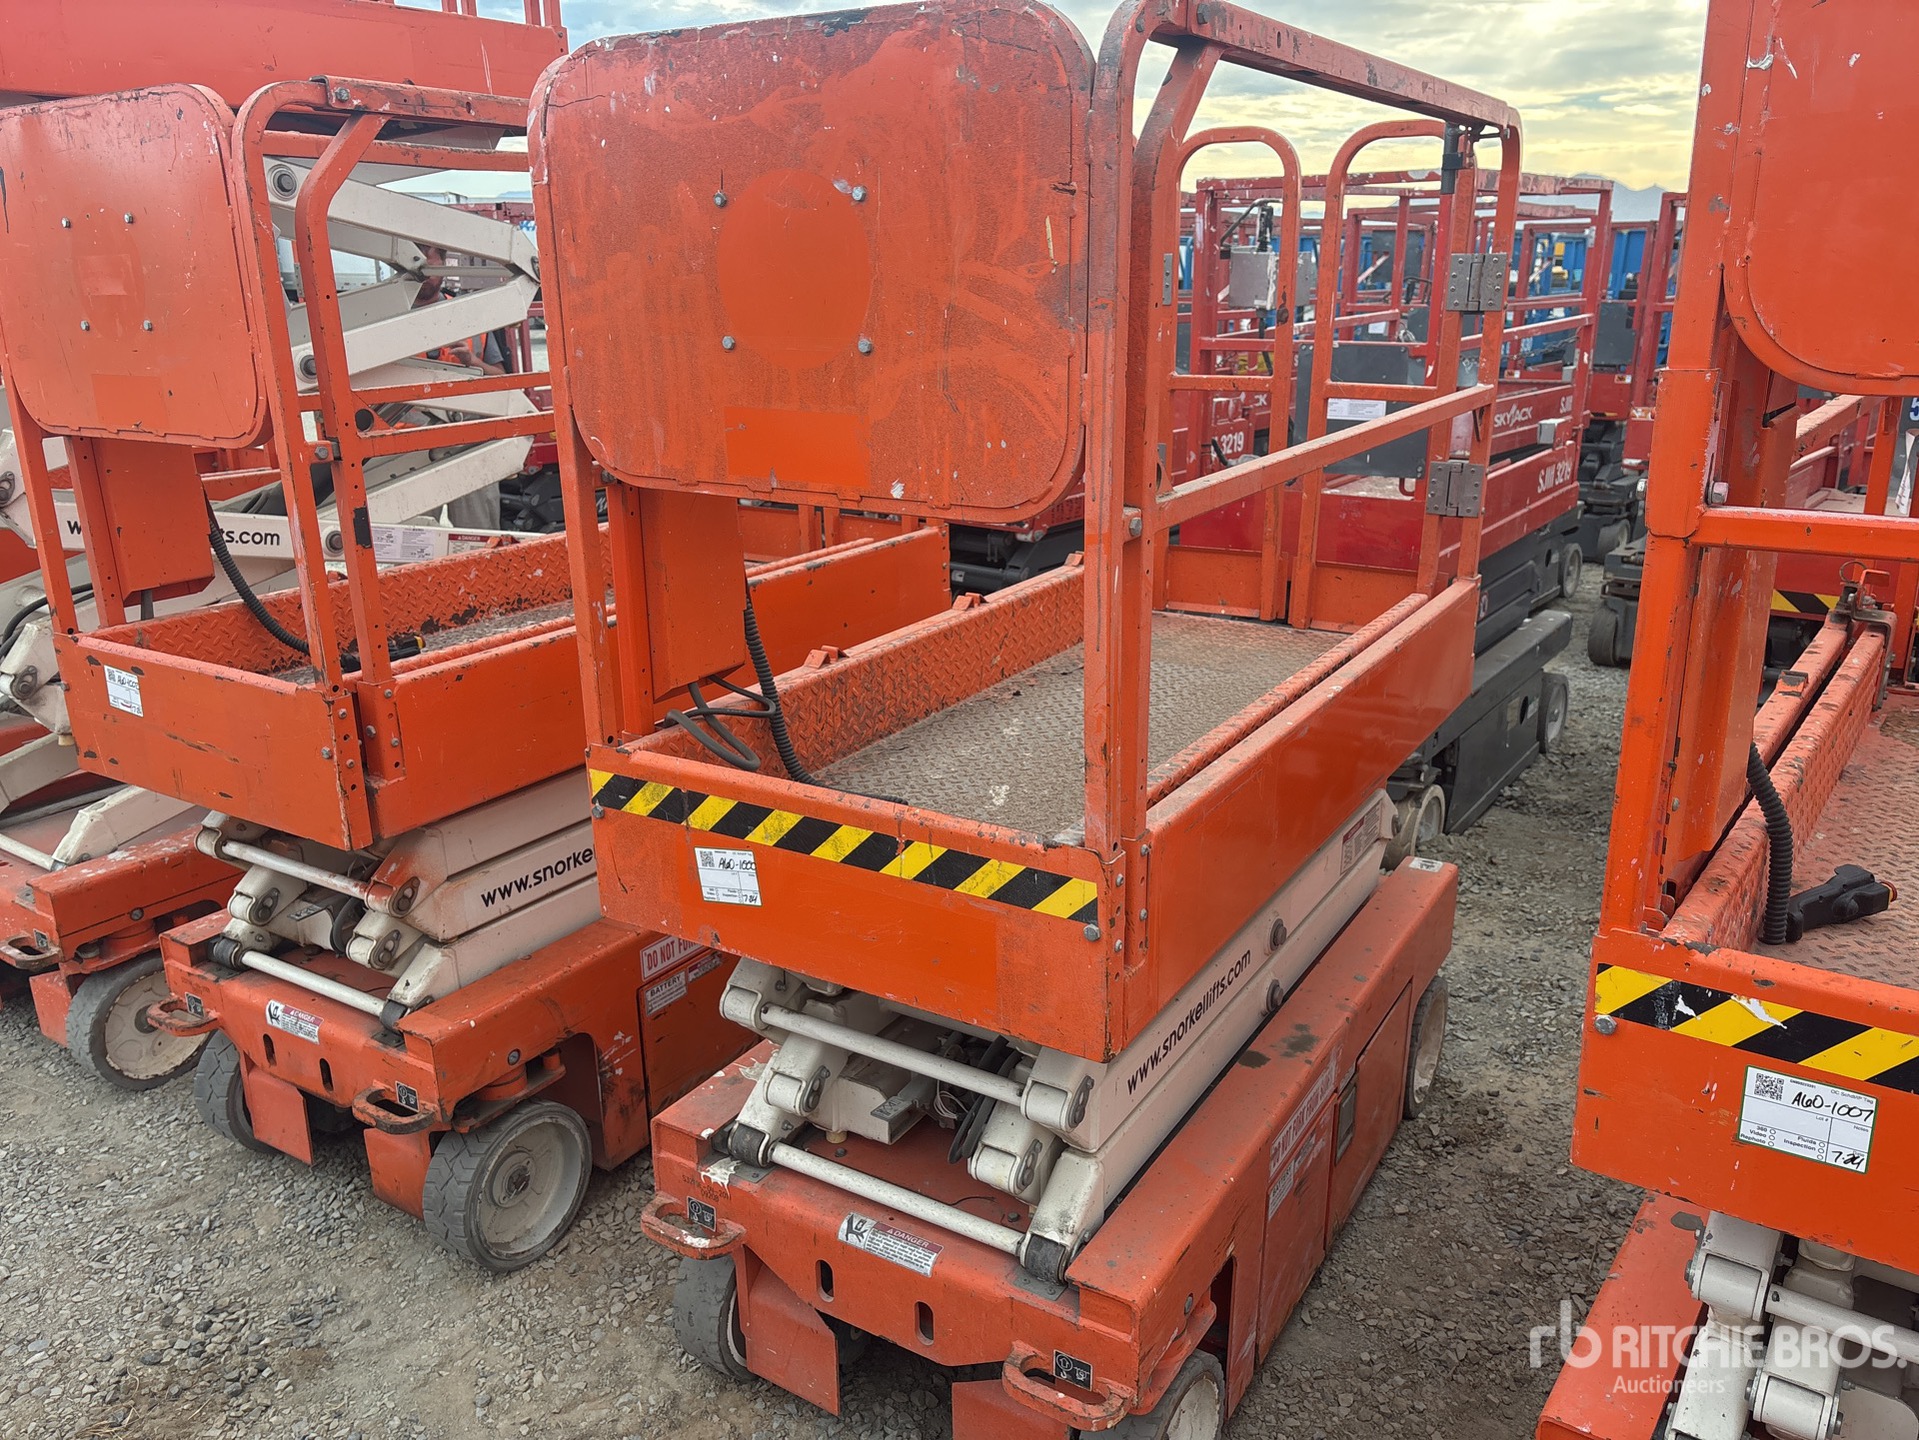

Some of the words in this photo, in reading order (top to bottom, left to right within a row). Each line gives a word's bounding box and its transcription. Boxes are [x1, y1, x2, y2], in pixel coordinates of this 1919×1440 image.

[1493, 403, 1533, 428] SKYJACK
[1220, 431, 1245, 455] 3219
[660, 940, 676, 964] NOT
[650, 974, 681, 997] BATTERY
[1126, 949, 1251, 1096] www.snorkellifts.com
[1791, 1091, 1874, 1122] A60-1007
[1740, 1133, 1766, 1144] Rephoto
[1749, 1129, 1767, 1138] Video
[1783, 1139, 1816, 1151] Inspection
[1797, 1136, 1817, 1145] Fluids
[893, 1230, 930, 1248] DANGER
